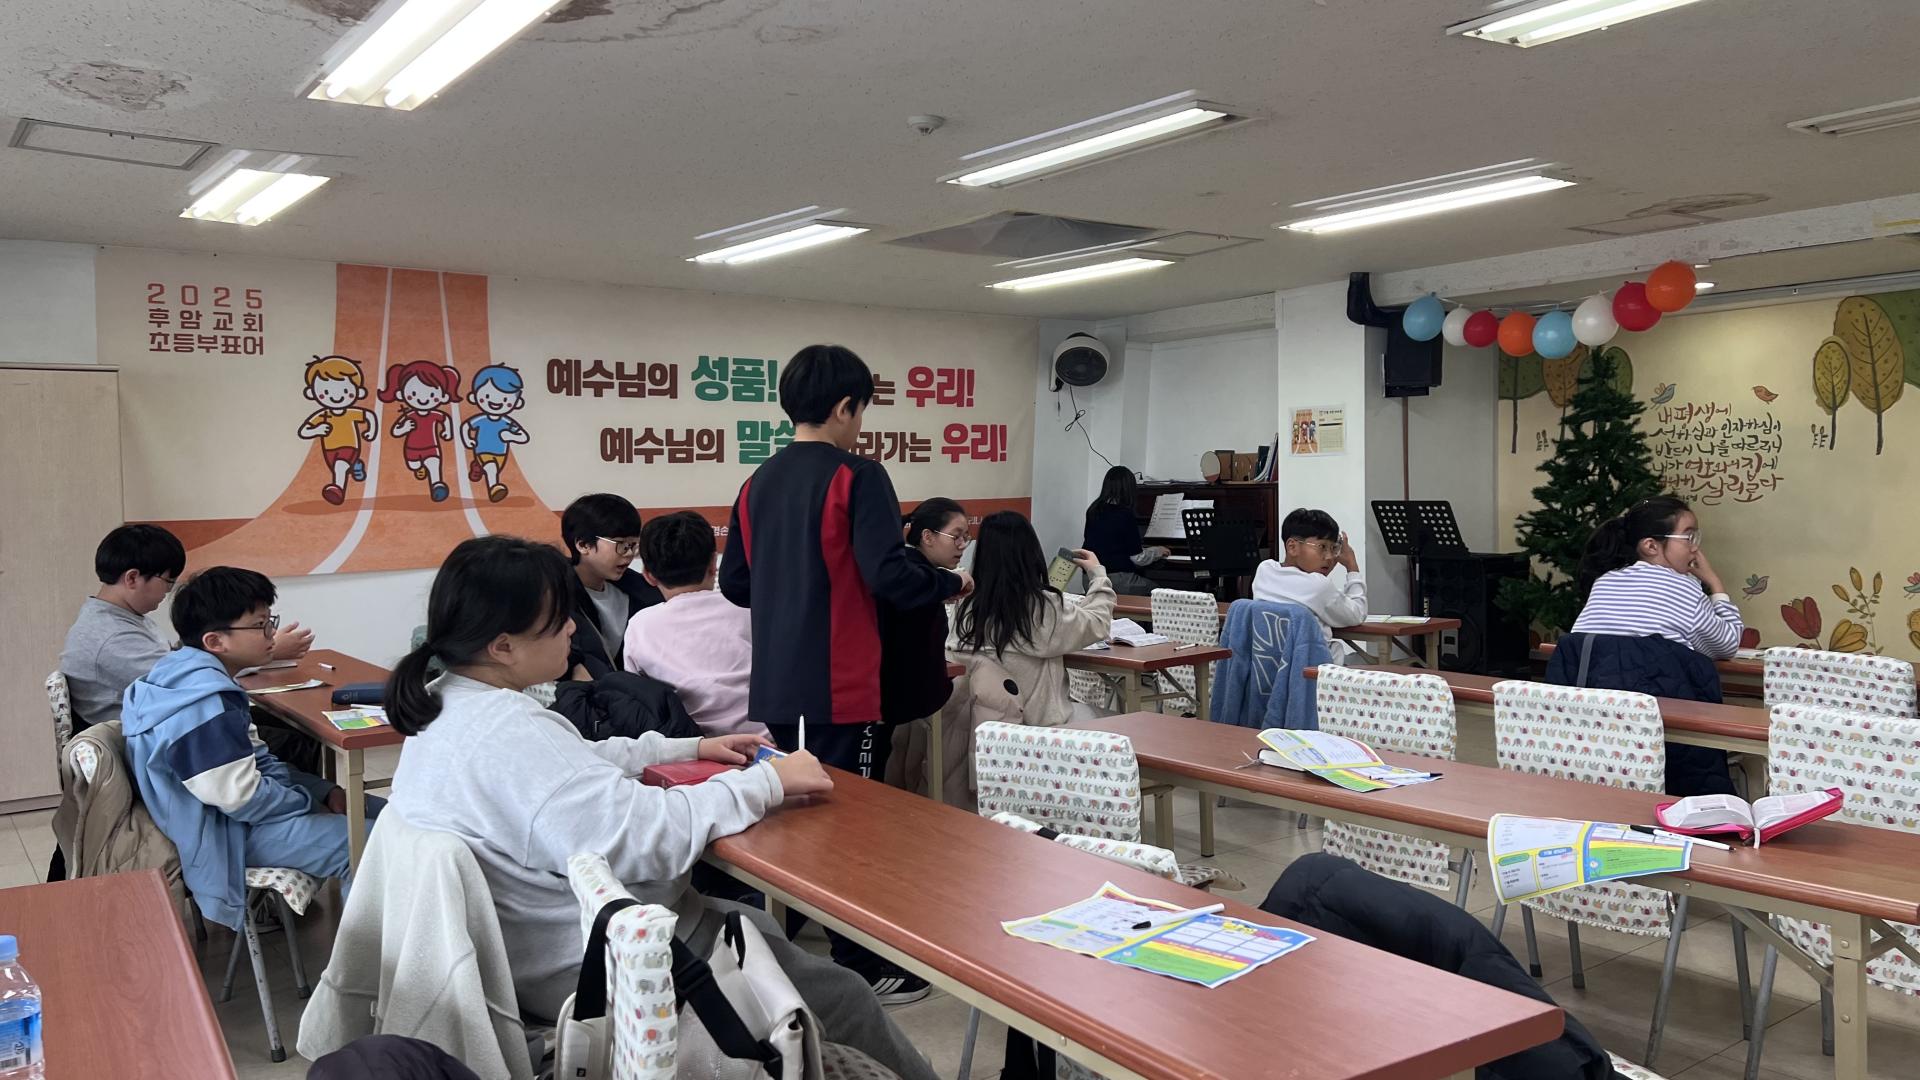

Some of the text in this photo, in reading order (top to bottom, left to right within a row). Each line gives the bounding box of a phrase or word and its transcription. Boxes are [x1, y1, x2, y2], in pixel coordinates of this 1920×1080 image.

[147, 282, 263, 309] 2025
[148, 307, 264, 332] 후암교회
[149, 331, 264, 356] 초등부표어
[546, 358, 678, 399] 예수님의
[691, 355, 778, 402] 성품!
[906, 366, 975, 407] 우리!
[600, 427, 725, 464] 예수님의
[941, 423, 1007, 463] 우리!
